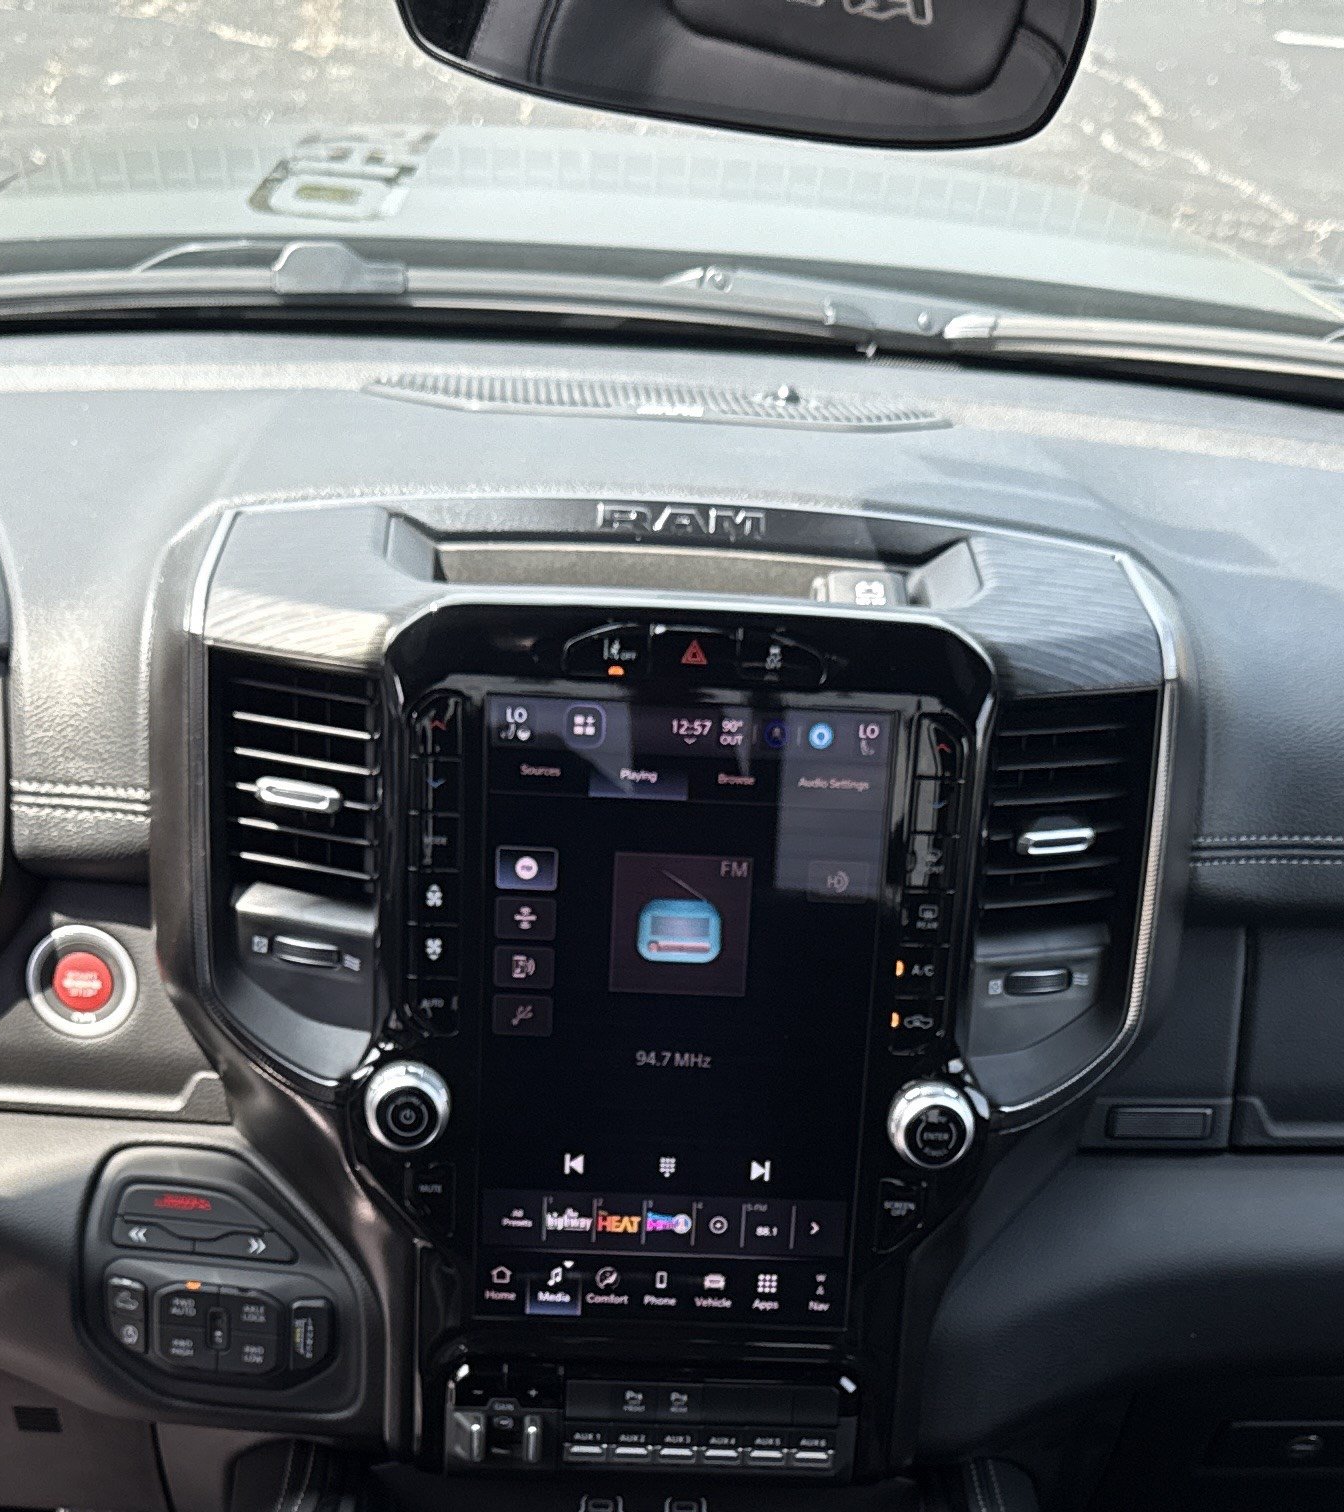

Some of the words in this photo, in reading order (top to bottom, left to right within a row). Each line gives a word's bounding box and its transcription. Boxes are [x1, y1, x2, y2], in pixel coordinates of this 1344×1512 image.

[597, 501, 766, 540] RAM
[506, 706, 528, 723] LO
[671, 718, 712, 735] 12:57
[858, 723, 880, 739] LO
[719, 734, 743, 746] OUT
[519, 763, 561, 777] Sources
[619, 768, 658, 783] Playing
[798, 777, 828, 789] Audio
[829, 779, 870, 792] Settings
[720, 861, 749, 878] FM
[911, 963, 936, 977] A/C
[635, 1050, 672, 1067] 94.7
[673, 1051, 712, 1068] MHz
[502, 1217, 533, 1228] Presets
[597, 1215, 642, 1233] HEAT
[484, 1289, 516, 1300] Home
[537, 1291, 571, 1302] Media
[586, 1292, 629, 1304] Comfort
[643, 1295, 677, 1306] Phone
[695, 1297, 732, 1308] Vehicle
[752, 1300, 779, 1311] Apps
[808, 1301, 830, 1312] Nav
[574, 1432, 593, 1441] AUX
[619, 1434, 638, 1442] AUX
[664, 1435, 684, 1443] AUX
[709, 1436, 729, 1445] AUX
[754, 1437, 774, 1445] AUX
[800, 1438, 819, 1447] AUX
